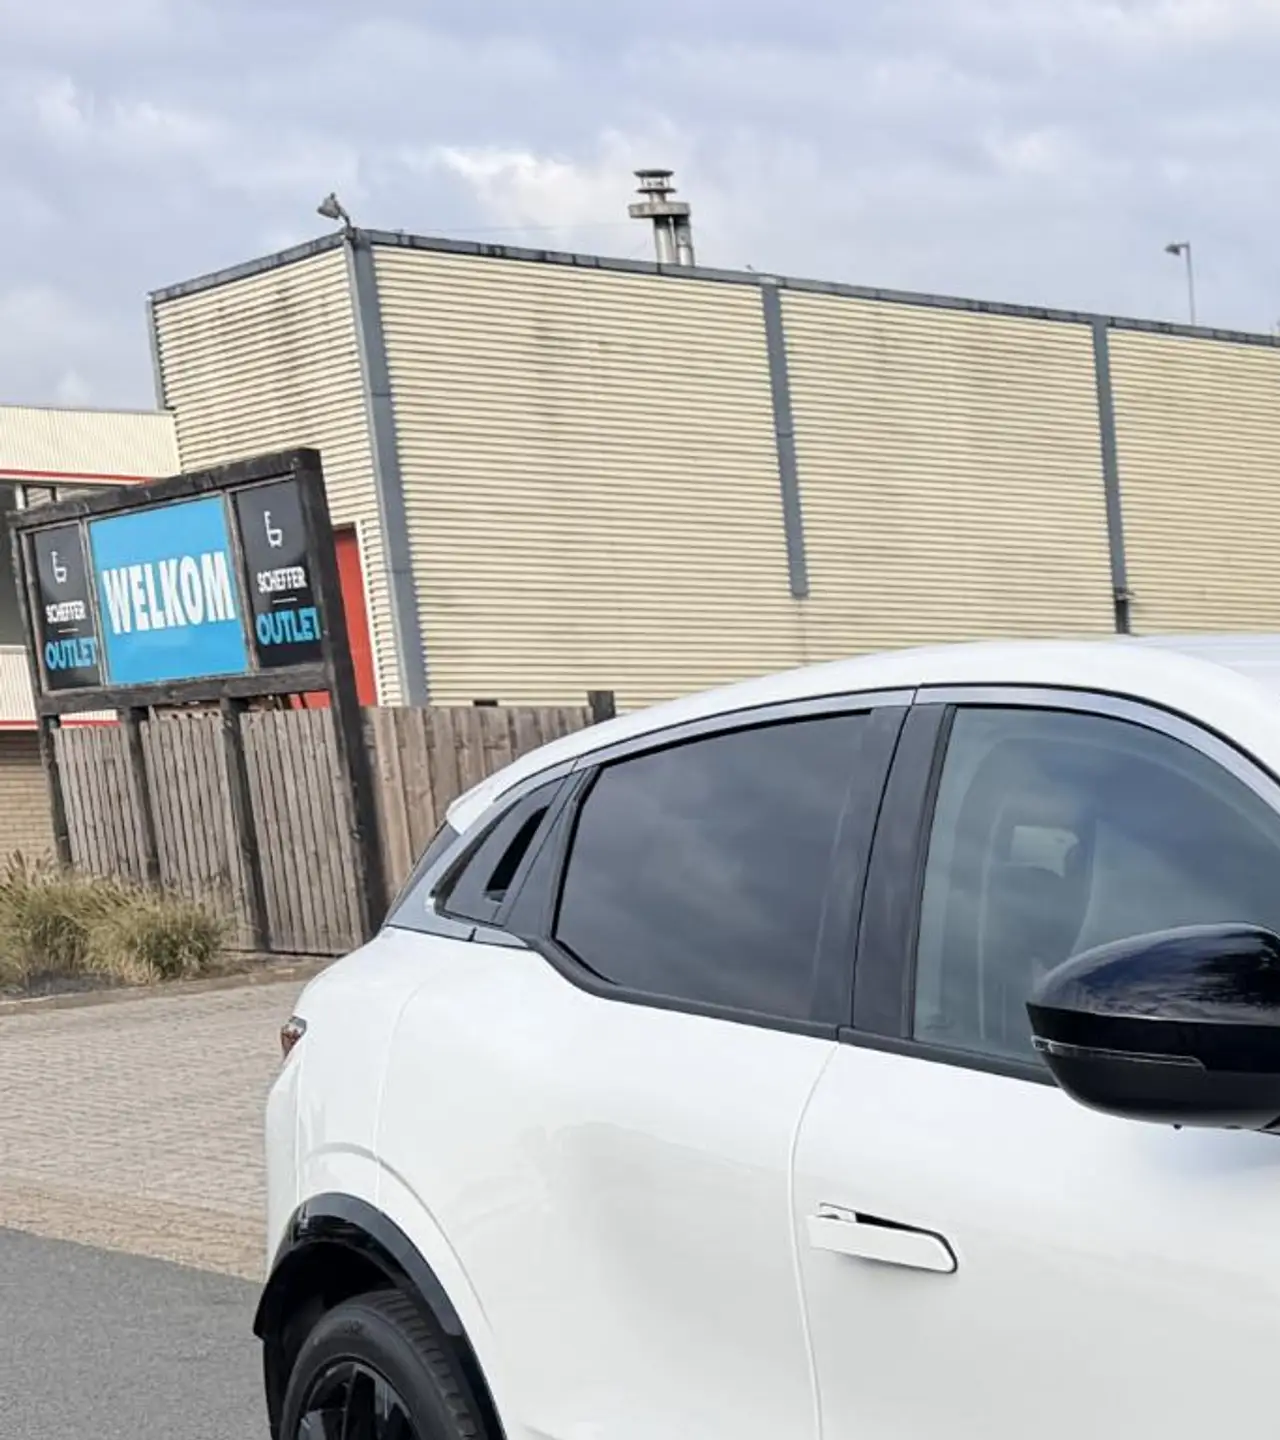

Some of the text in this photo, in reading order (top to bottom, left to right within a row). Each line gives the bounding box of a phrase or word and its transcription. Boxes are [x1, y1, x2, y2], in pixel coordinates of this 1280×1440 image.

[102, 551, 236, 635] WELKOM
[257, 566, 307, 593] SCHEFFER
[46, 600, 86, 624] SCHEFFER
[256, 607, 321, 645] OUTLET
[45, 637, 97, 670] OUTLET
